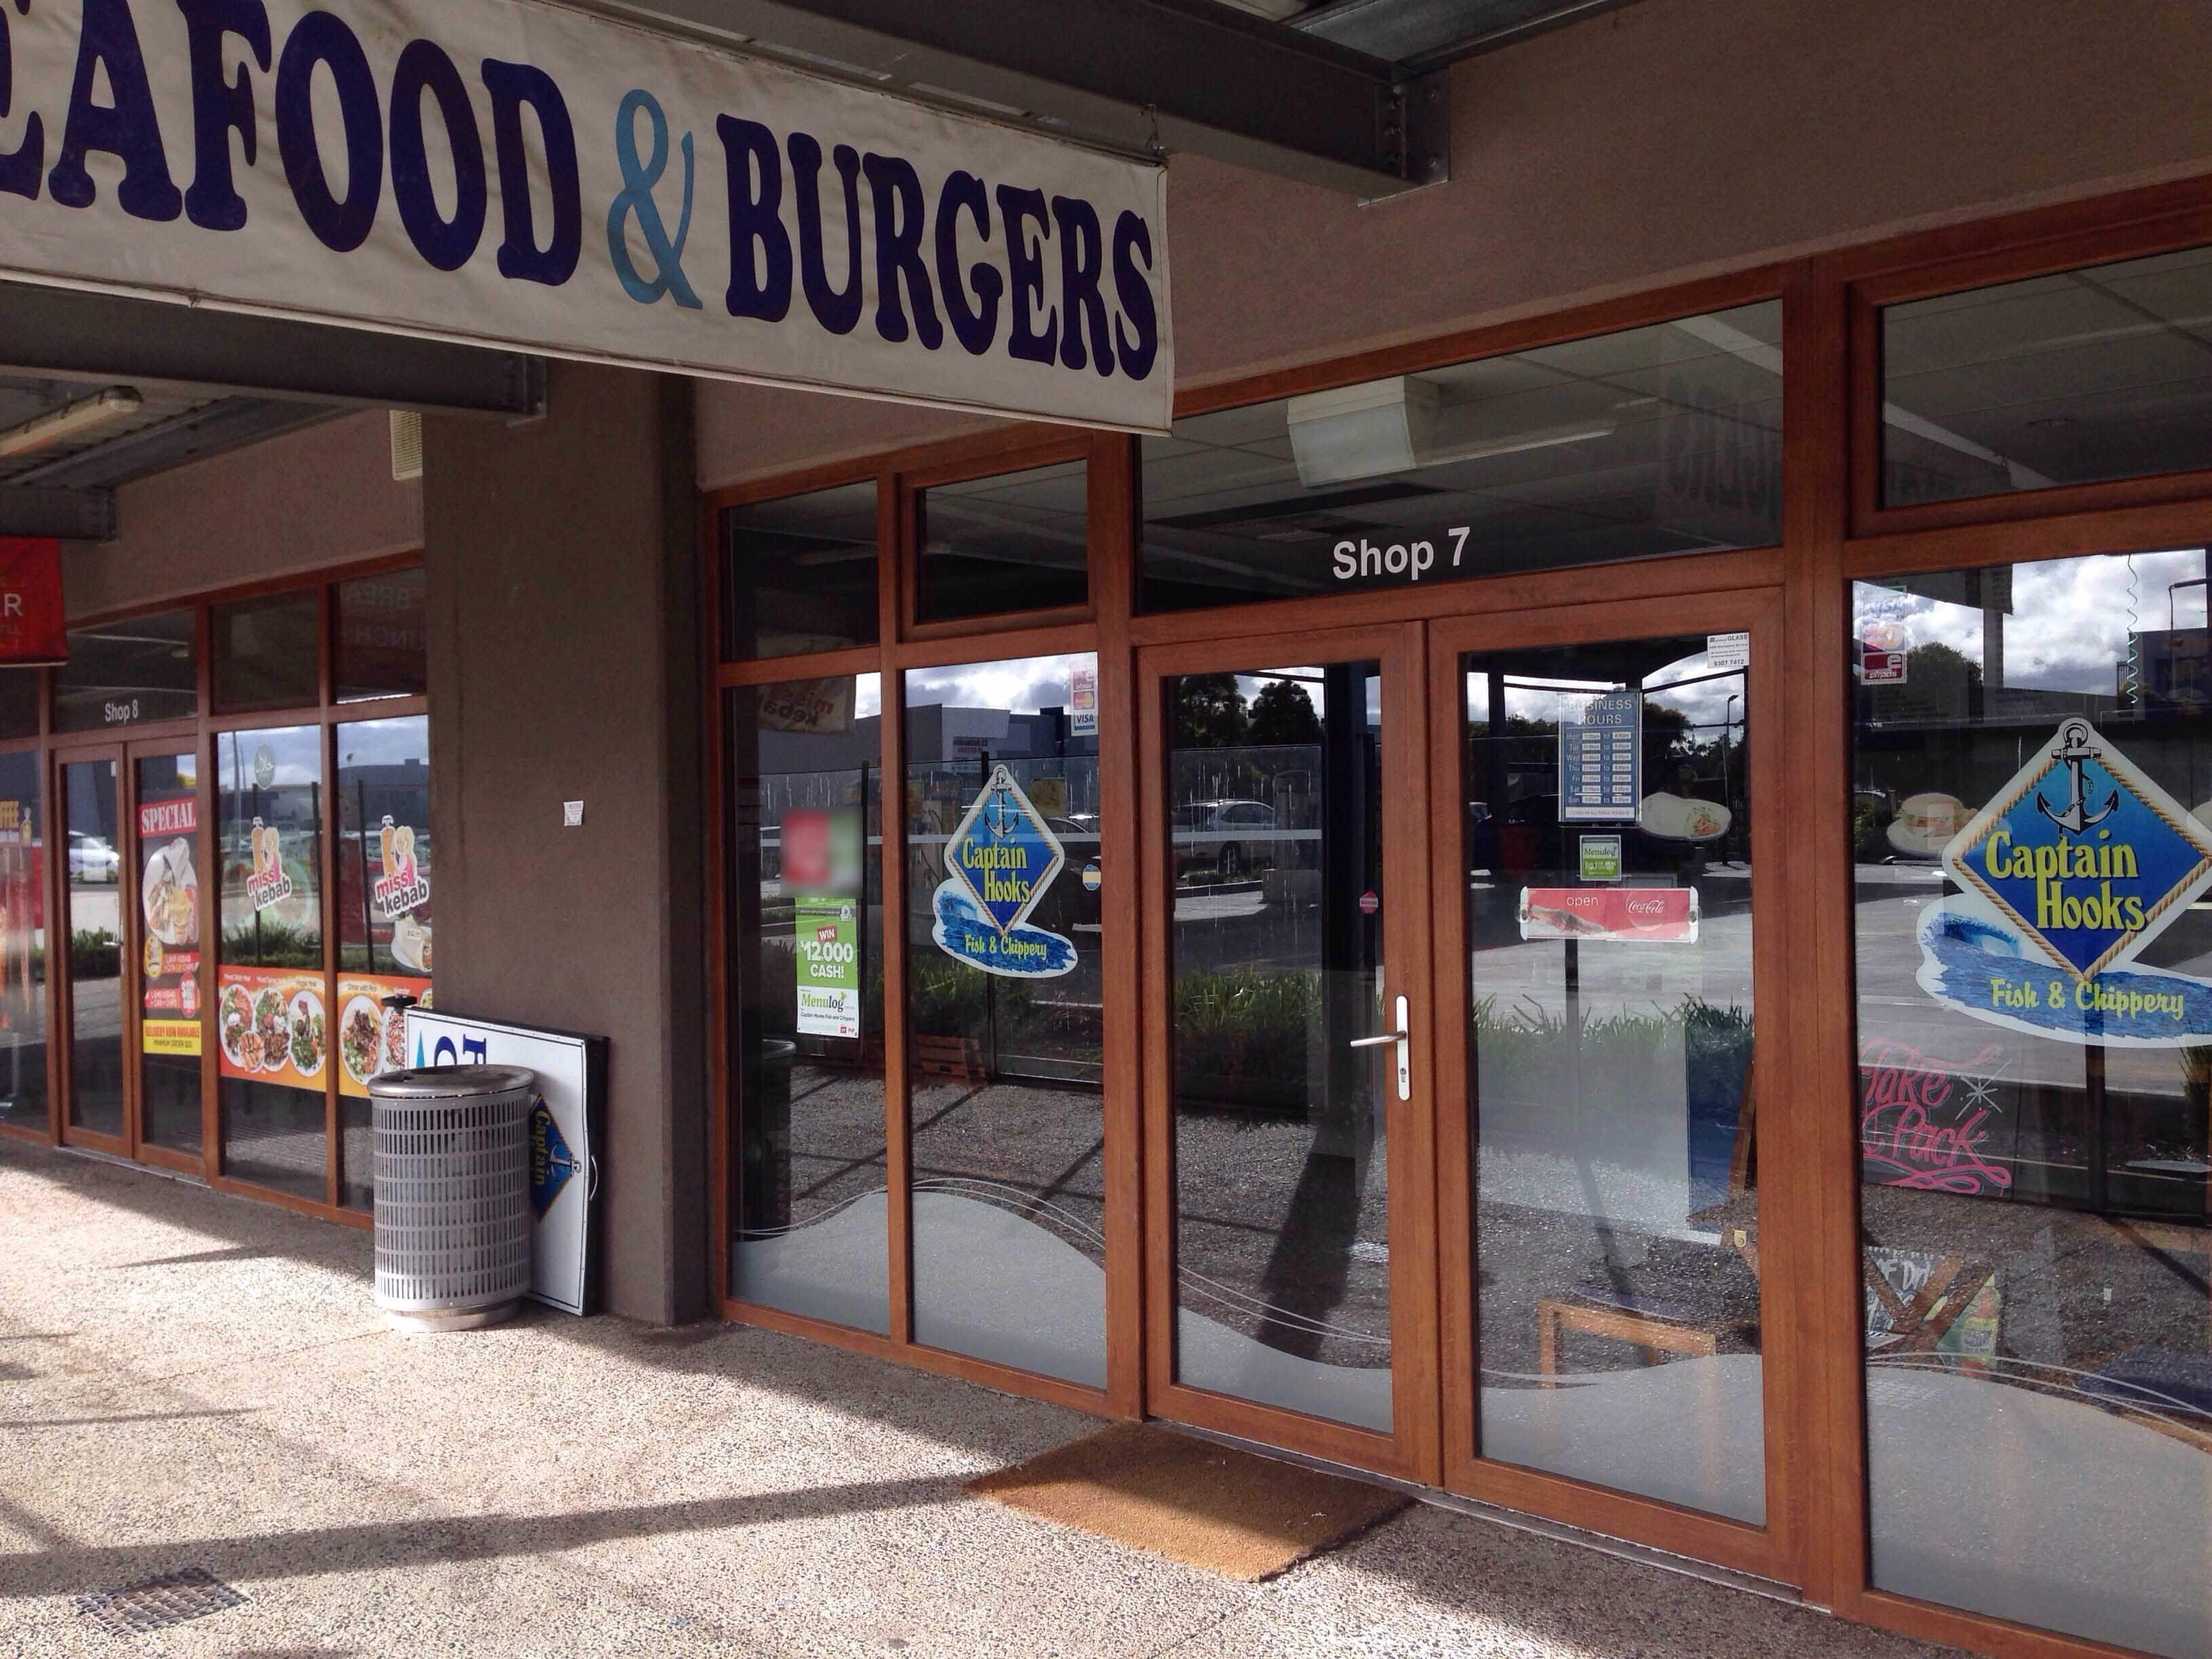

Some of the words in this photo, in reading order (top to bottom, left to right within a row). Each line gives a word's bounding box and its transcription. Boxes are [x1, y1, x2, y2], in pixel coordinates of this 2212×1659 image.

[607, 89, 703, 310] &
[716, 112, 1158, 381] BURGERS
[1332, 539, 1434, 581] Shop
[1448, 526, 1470, 567] 7
[104, 703, 129, 724] Shop
[132, 699, 138, 719] 8
[1568, 699, 1633, 711] BUSINESS
[1076, 715, 1094, 723] VISA
[1578, 714, 1622, 725] HOURS
[141, 802, 197, 834] SPECIAL
[962, 837, 1028, 876] Captain
[1583, 847, 1616, 857] Menulog
[1985, 830, 2139, 888] Captain
[248, 869, 274, 894] miss
[255, 876, 291, 907] kebab
[376, 872, 409, 900] miss
[984, 867, 1031, 904] Hooks
[384, 880, 428, 914] kebab
[1566, 896, 1599, 908] open
[2036, 880, 2146, 933] Hooks
[819, 928, 835, 941] WIN
[965, 934, 987, 954] Fish
[989, 937, 998, 952] &
[1001, 936, 1048, 960] Chippery
[800, 939, 854, 963] $12,000
[810, 964, 845, 979] CASH!
[802, 992, 844, 1012] Menulog
[1990, 978, 2039, 1009] Fish
[2047, 983, 2066, 1009] &
[2075, 981, 2184, 1018] Chippery
[1862, 1101, 1990, 1168] Pack
